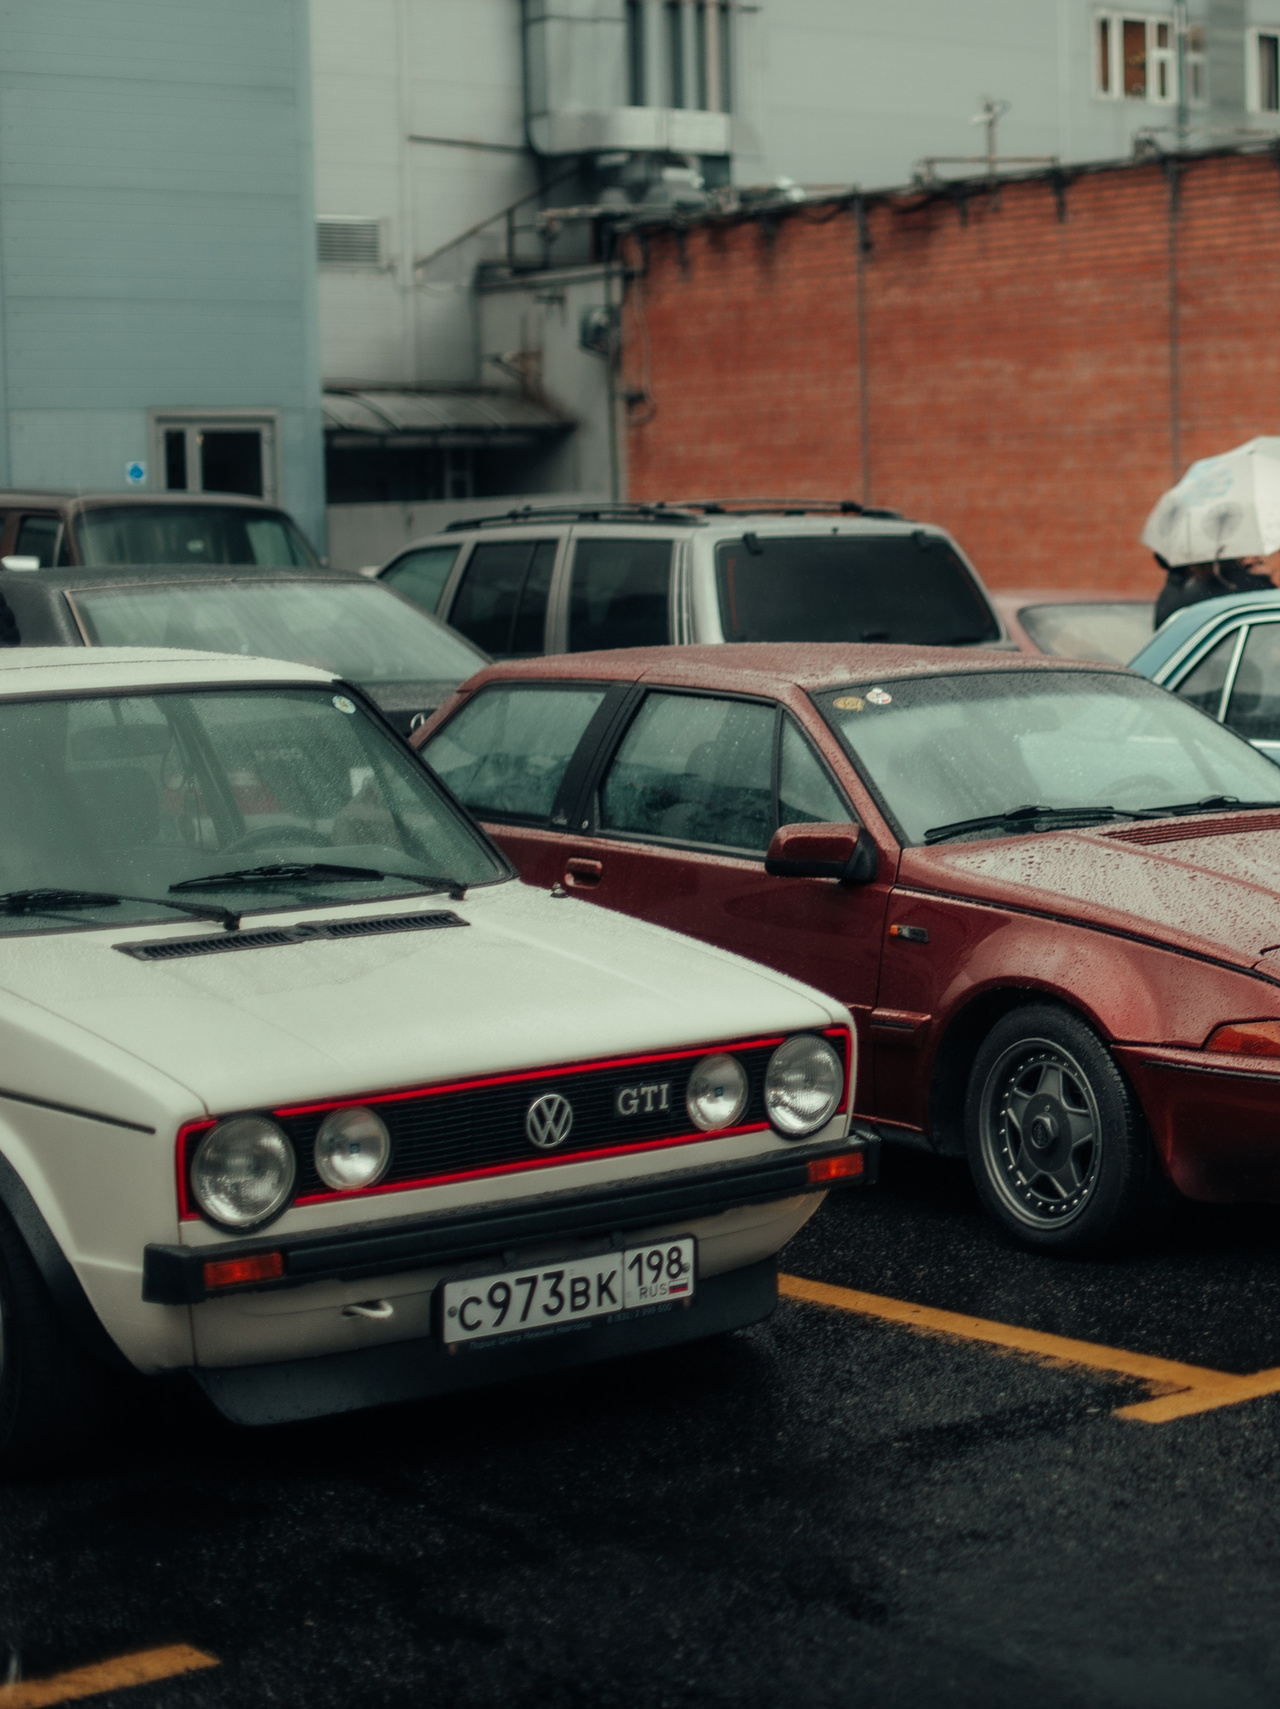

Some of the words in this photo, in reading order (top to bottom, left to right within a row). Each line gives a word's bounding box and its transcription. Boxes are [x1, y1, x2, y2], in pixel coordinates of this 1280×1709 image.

[617, 1083, 670, 1115] GTI
[458, 1269, 618, 1331] С973ВК
[627, 1246, 683, 1287] 198
[639, 1283, 668, 1299] RUS
